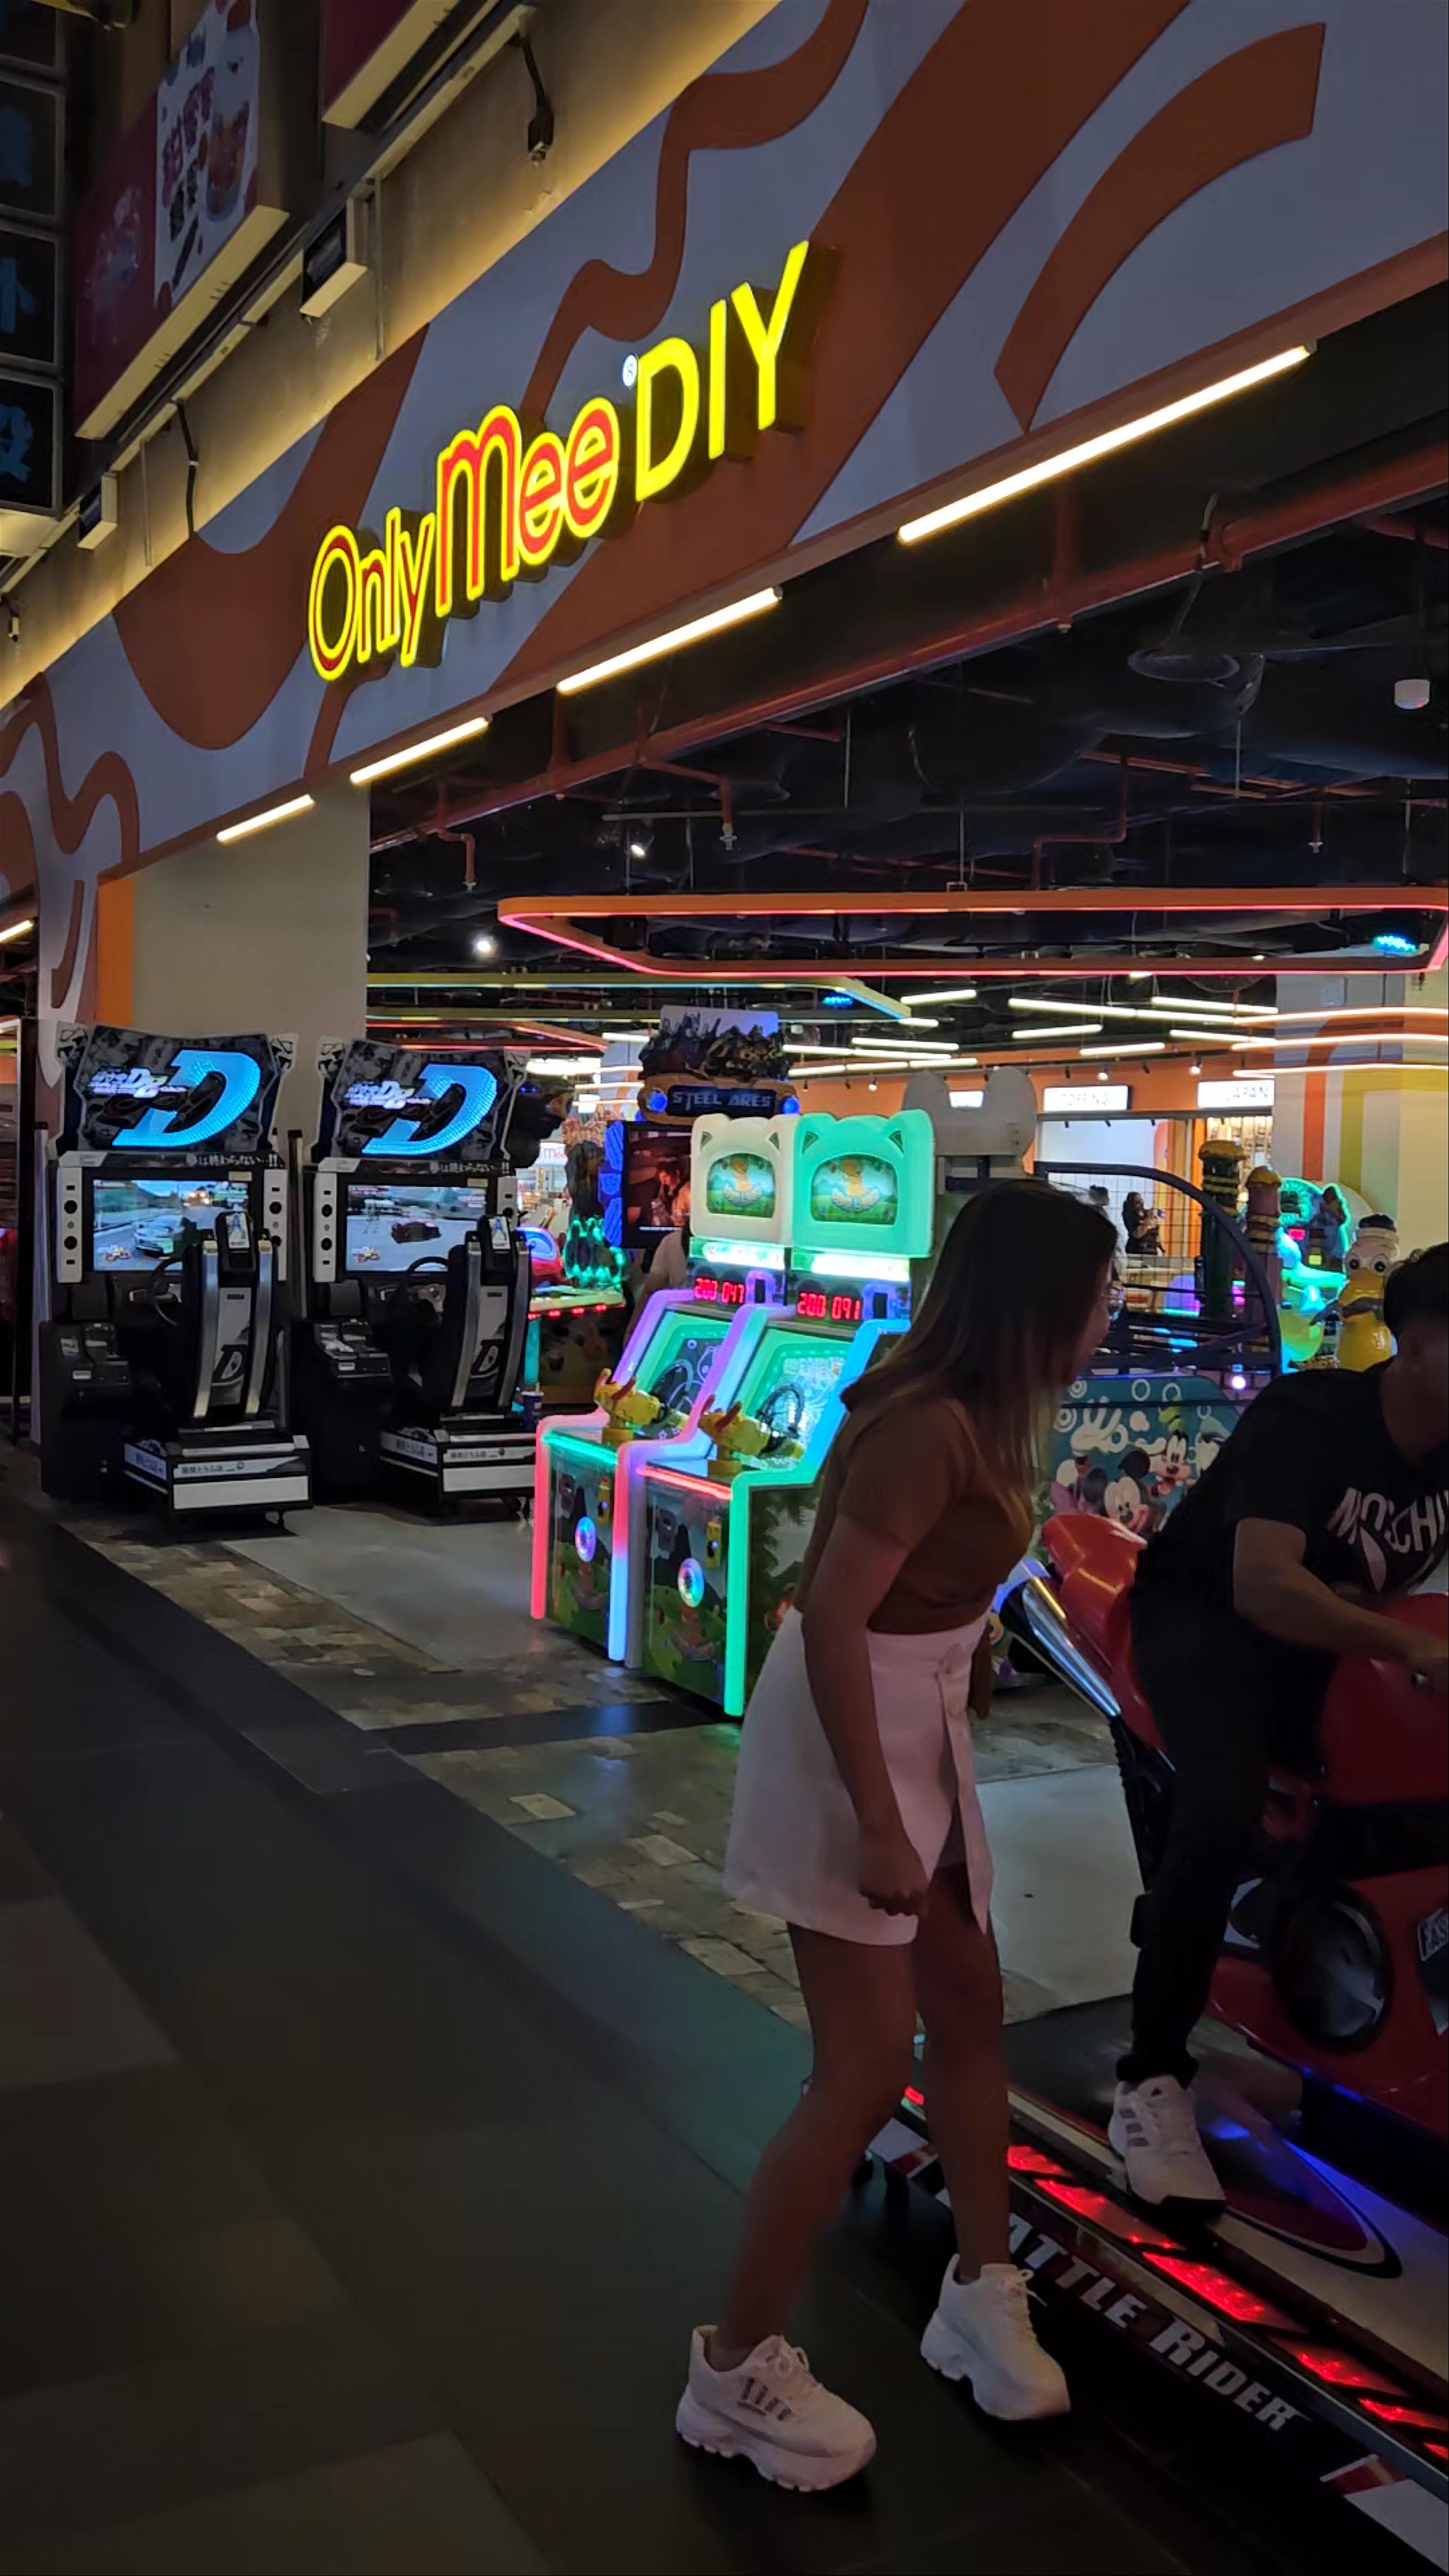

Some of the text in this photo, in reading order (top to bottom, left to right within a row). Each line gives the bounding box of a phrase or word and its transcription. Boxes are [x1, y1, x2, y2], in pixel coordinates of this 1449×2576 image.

[636, 240, 808, 501] DIY
[673, 1092, 771, 1110] STEEL ARES
[721, 1282, 744, 1303] 047
[832, 1296, 860, 1320] 091
[1008, 2213, 1314, 2432] ATTLE RIDER
